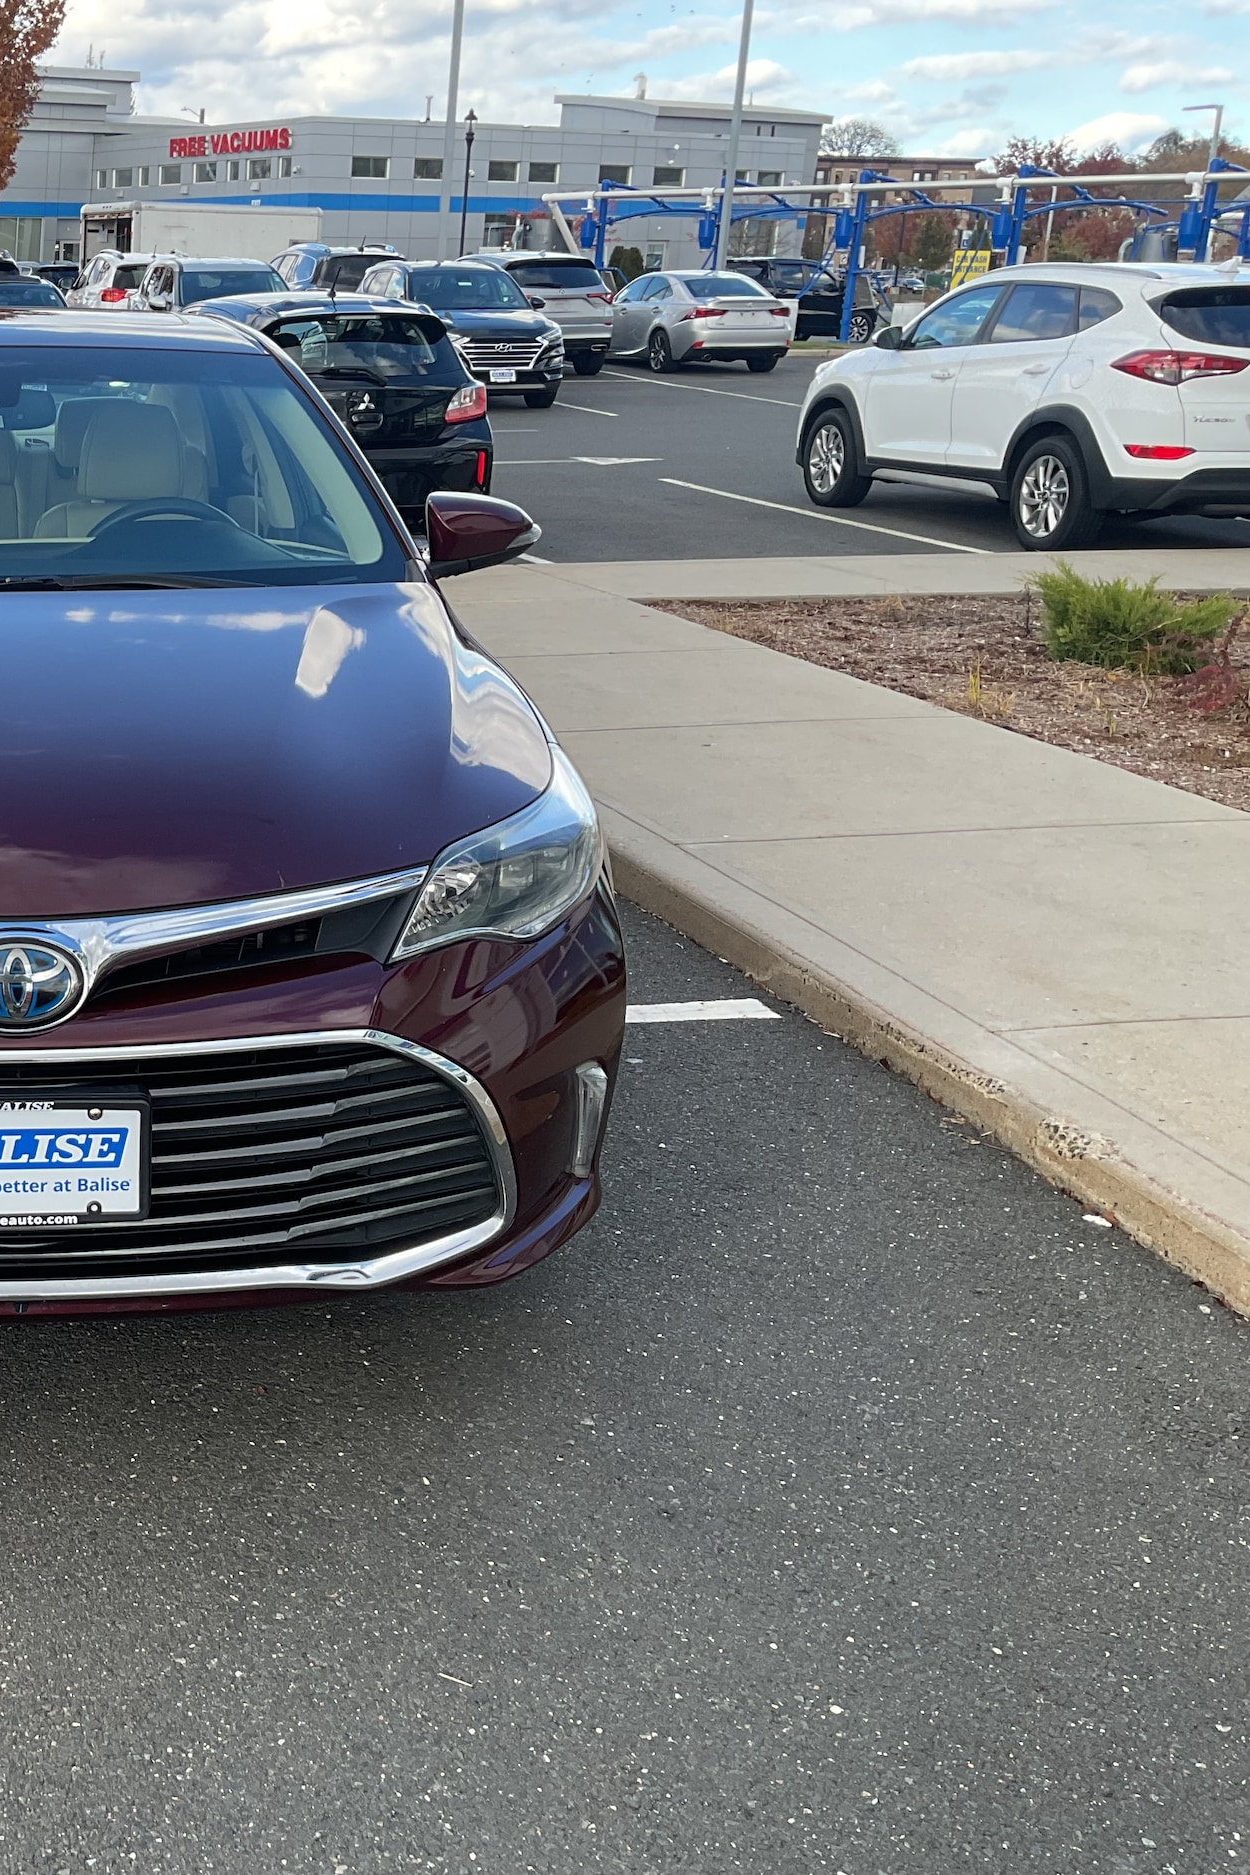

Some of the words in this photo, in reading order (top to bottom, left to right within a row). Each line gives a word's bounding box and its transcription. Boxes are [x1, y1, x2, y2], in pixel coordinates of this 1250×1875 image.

[169, 136, 209, 158] FREE
[211, 128, 292, 155] VACUUMS
[54, 1180, 72, 1193] at
[77, 1178, 131, 1192] Balise
